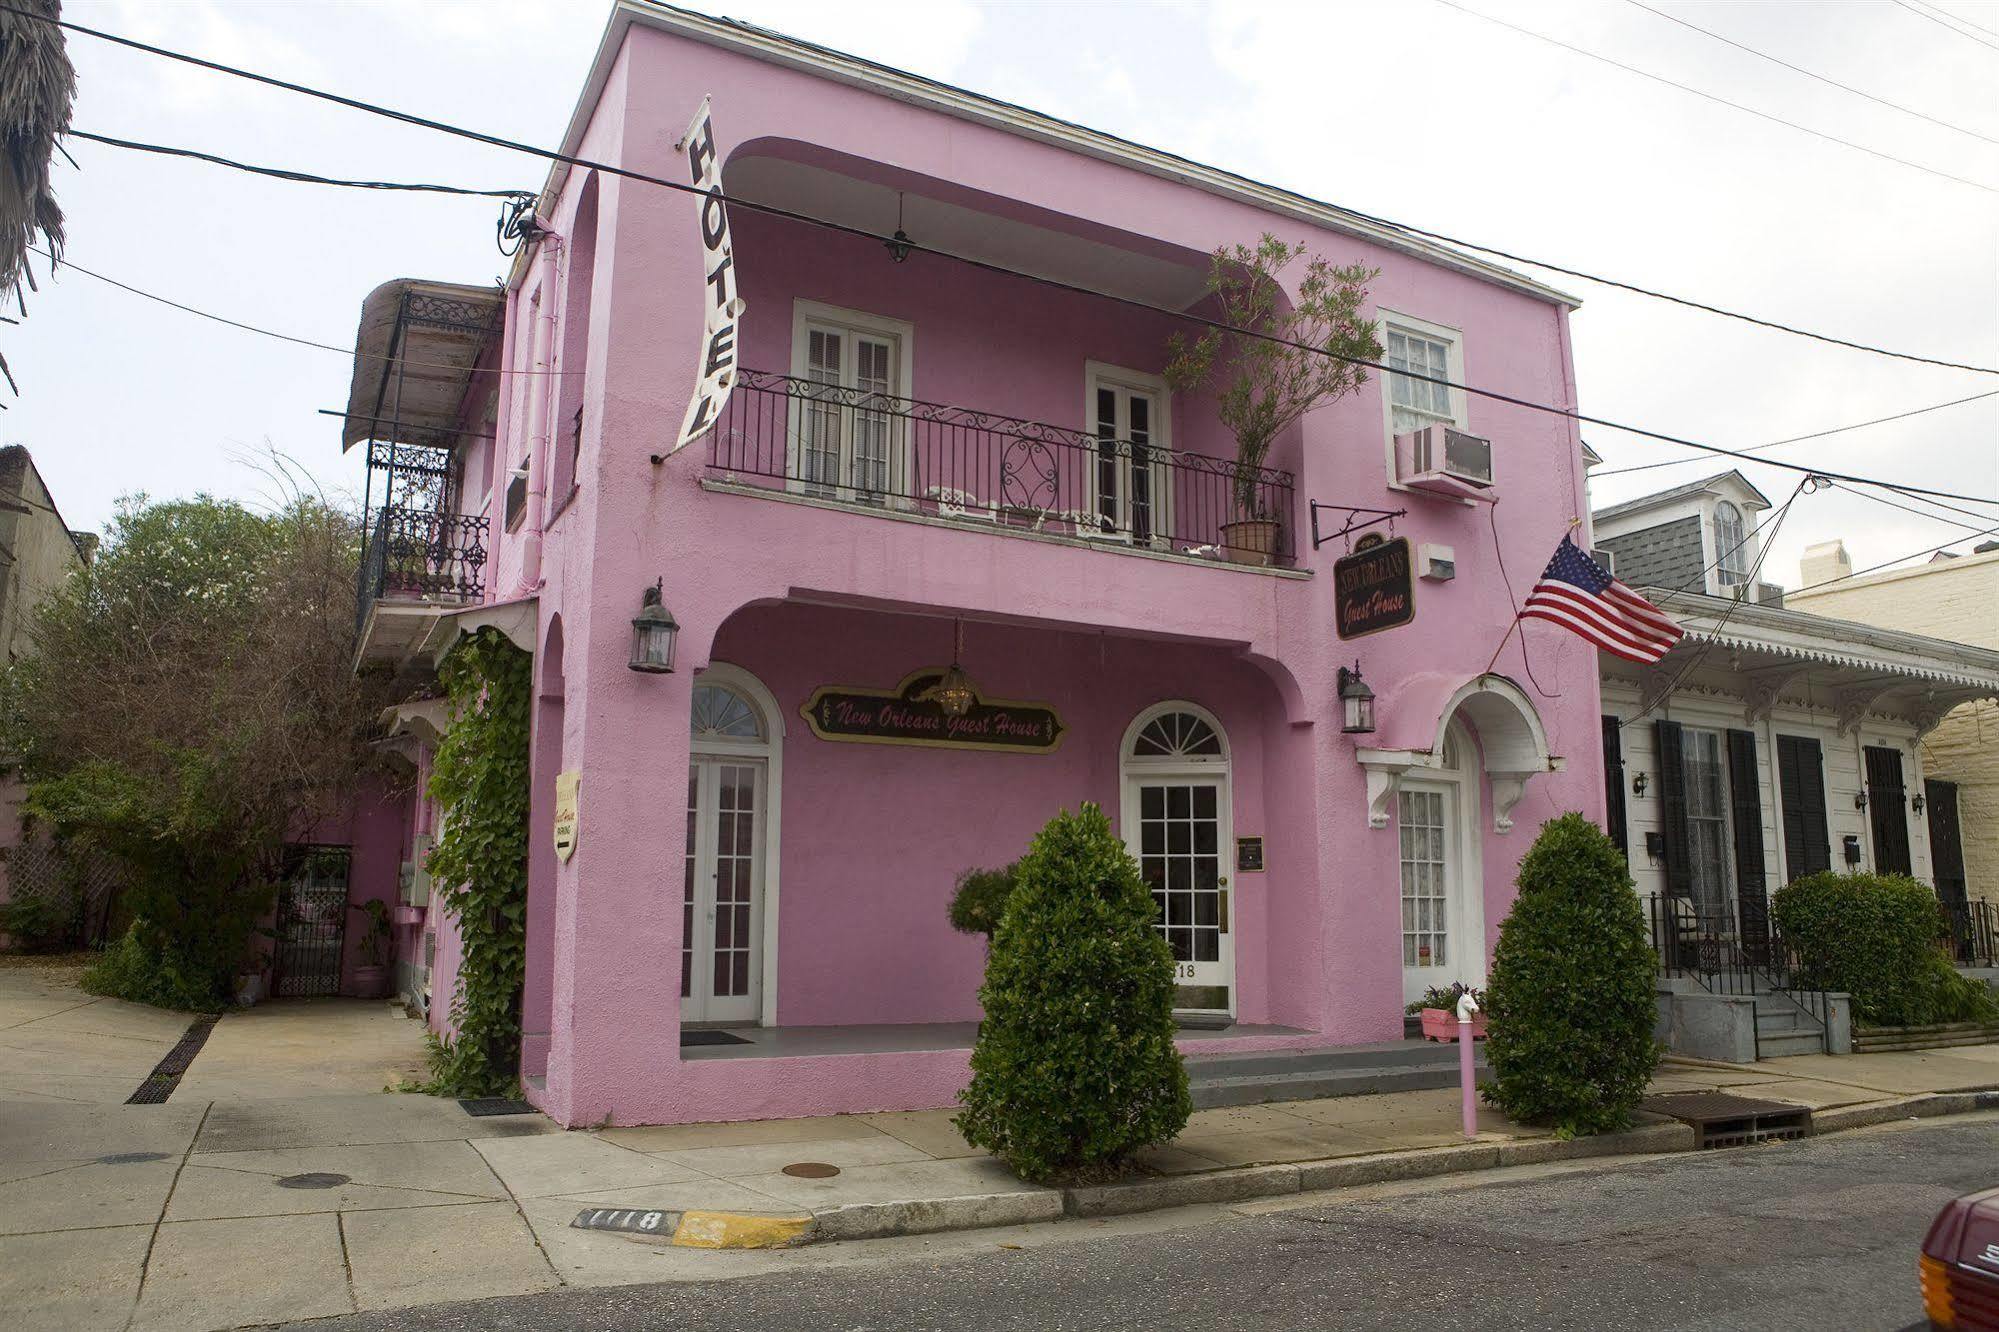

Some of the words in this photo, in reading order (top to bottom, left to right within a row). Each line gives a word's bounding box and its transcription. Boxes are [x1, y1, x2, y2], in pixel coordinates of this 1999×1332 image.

[688, 115, 735, 438] HOTEL
[1361, 551, 1405, 586] ORLEANS
[1344, 598, 1370, 632] Guest
[1372, 589, 1405, 617] House
[835, 701, 874, 725] New
[880, 704, 940, 730] Orleans
[945, 715, 991, 739] Guest
[992, 712, 1041, 736] House
[589, 1210, 662, 1230] 1118
